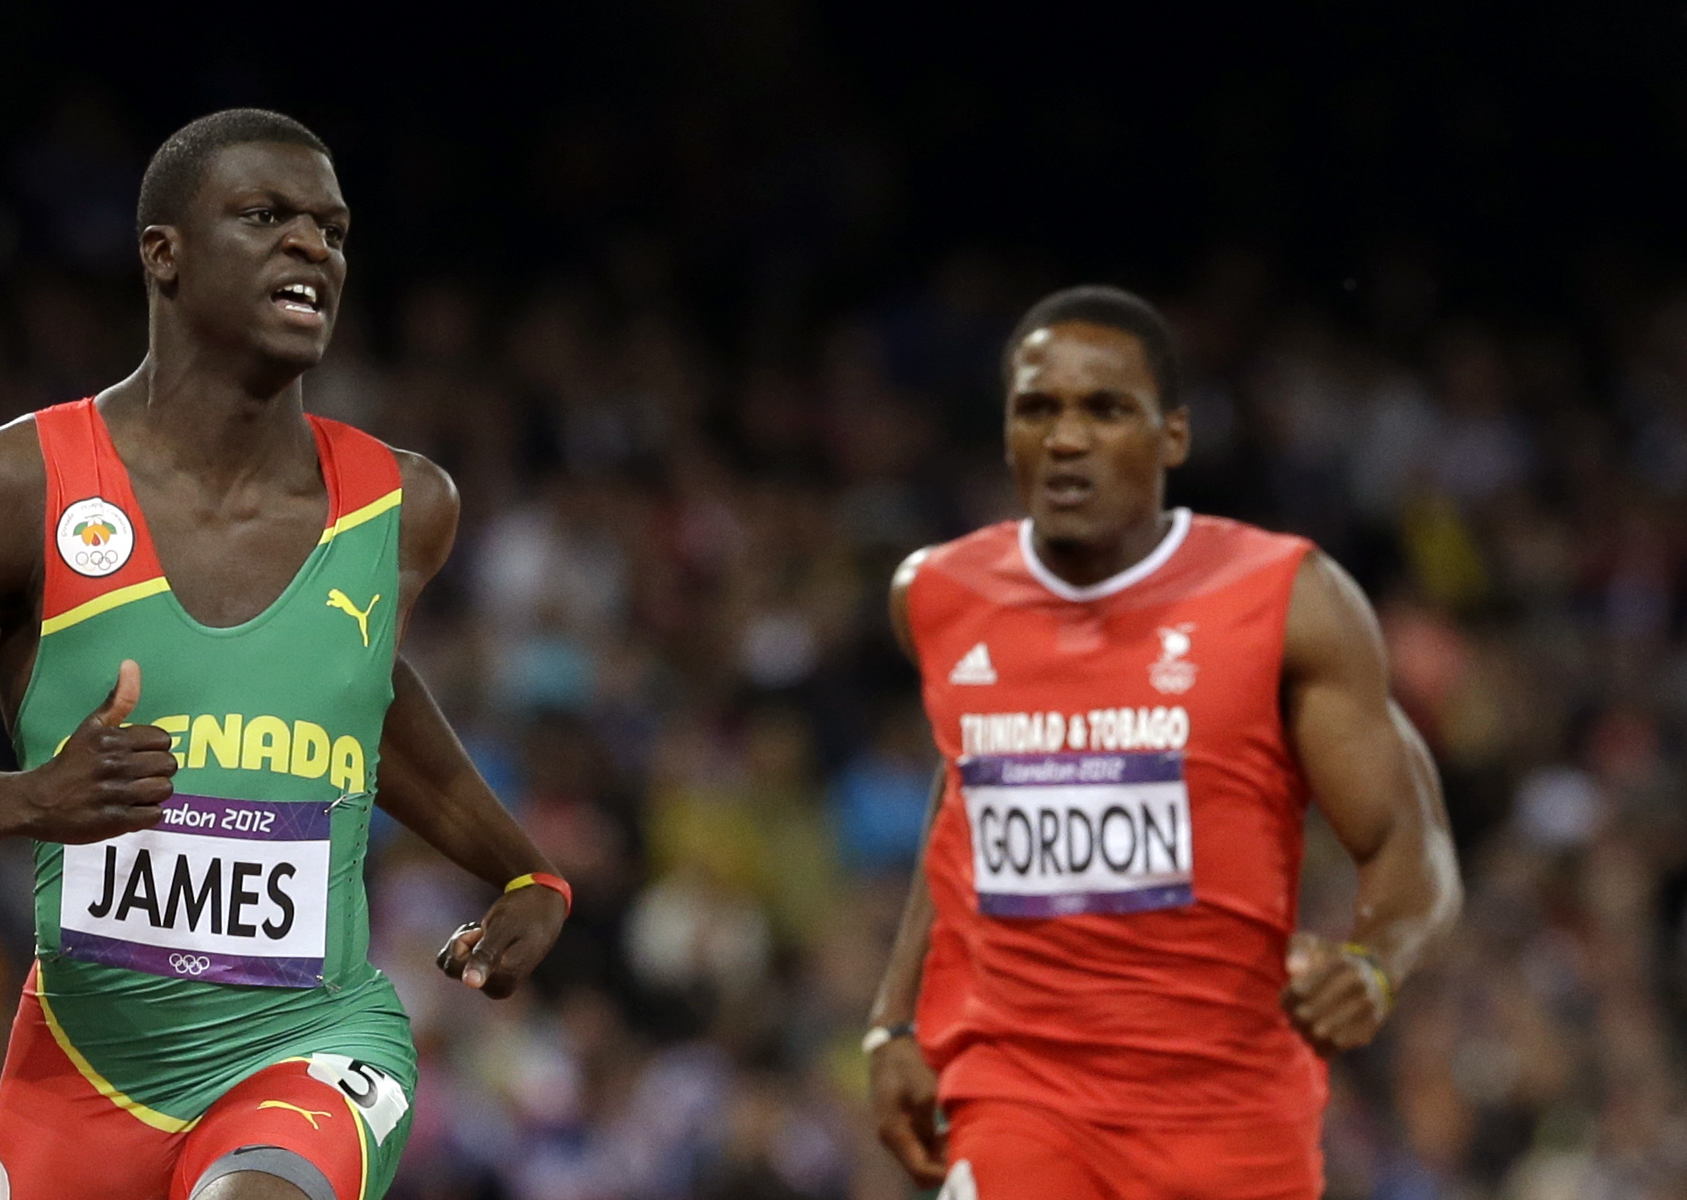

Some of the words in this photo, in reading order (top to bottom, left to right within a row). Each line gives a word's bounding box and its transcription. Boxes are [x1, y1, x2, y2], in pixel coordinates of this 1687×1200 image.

[52, 714, 365, 793] ENADA
[961, 712, 1065, 753] TRINIDAD
[1068, 713, 1087, 749] &
[1088, 706, 1189, 750] TOBAGO
[161, 803, 216, 829] ndon
[221, 807, 276, 833] 2012
[980, 802, 1180, 875] GORDON
[87, 844, 297, 940] JAMES
[337, 1059, 385, 1109] 5
